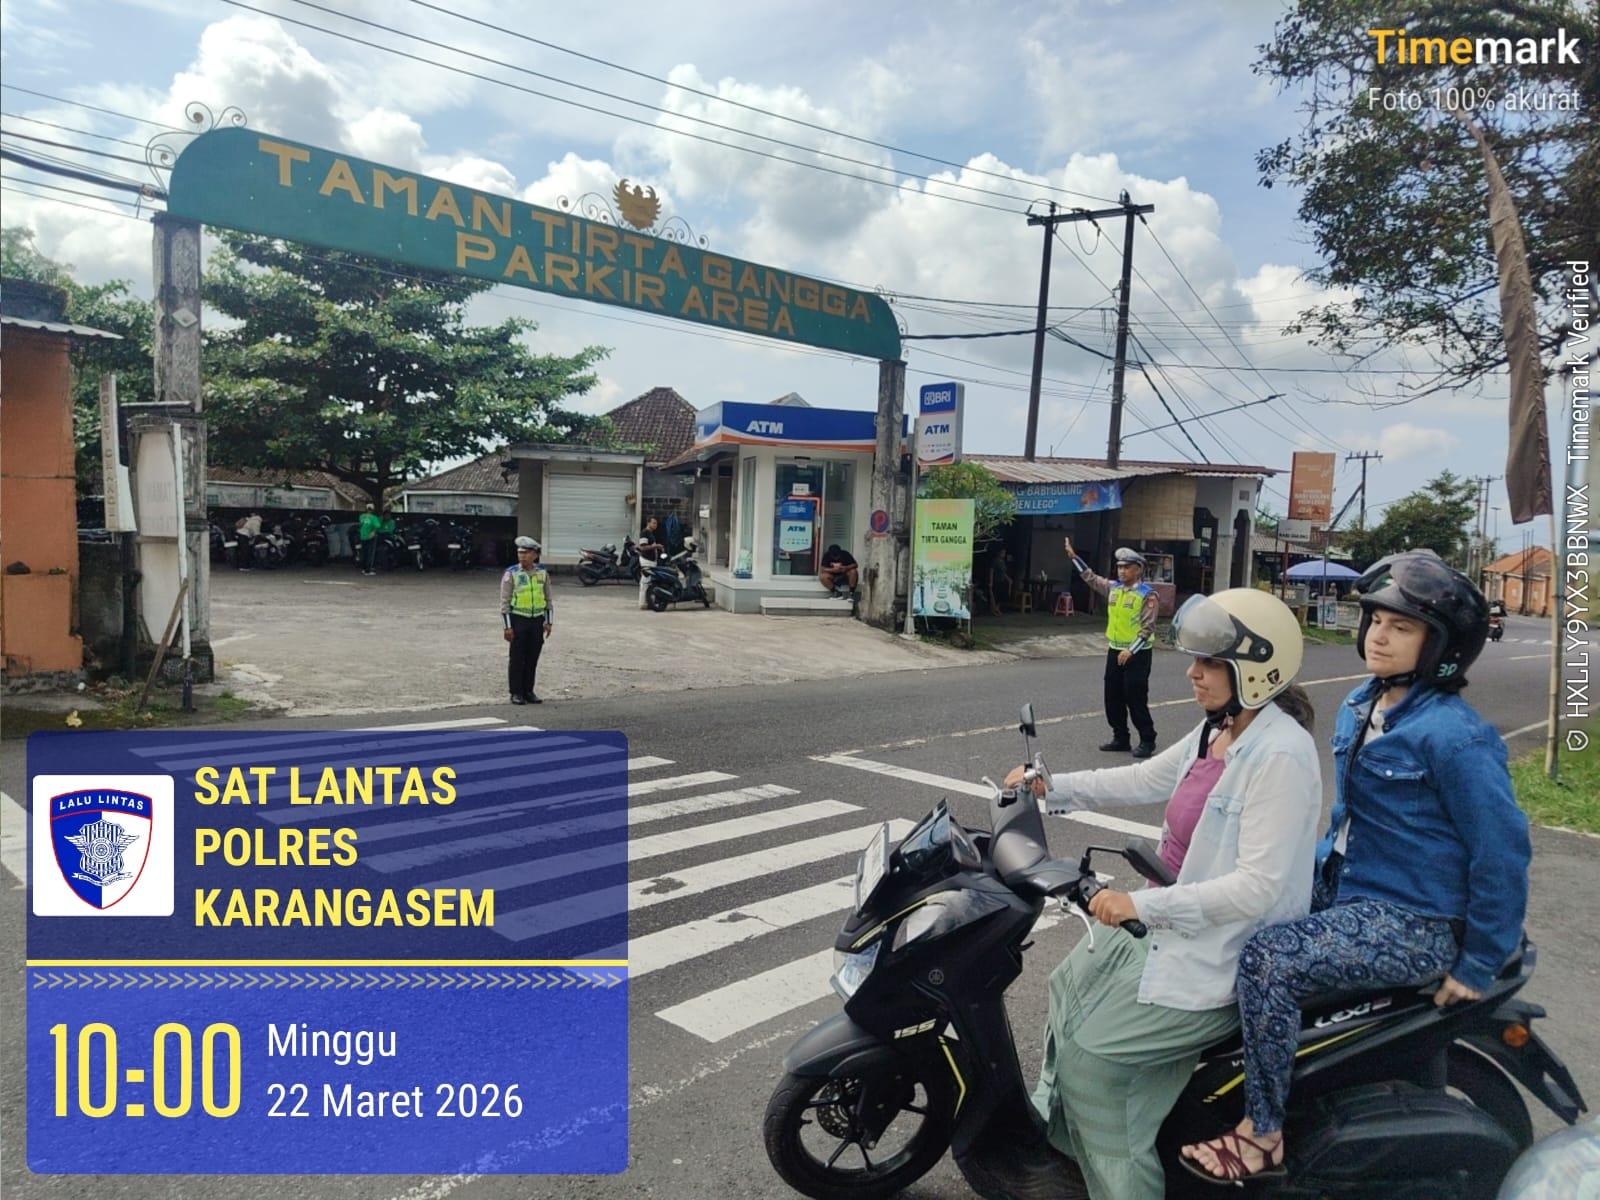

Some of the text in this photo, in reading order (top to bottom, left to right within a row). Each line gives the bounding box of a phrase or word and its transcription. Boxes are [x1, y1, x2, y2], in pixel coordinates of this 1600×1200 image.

[258, 138, 871, 324] TAMAN TIRTA GANGGA
[456, 231, 795, 337] PARKIR AREA
[746, 420, 784, 435] ATM
[924, 424, 951, 436] ATM
[931, 522, 958, 531] TAMAN
[921, 535, 967, 544] TIRTA GANGGA
